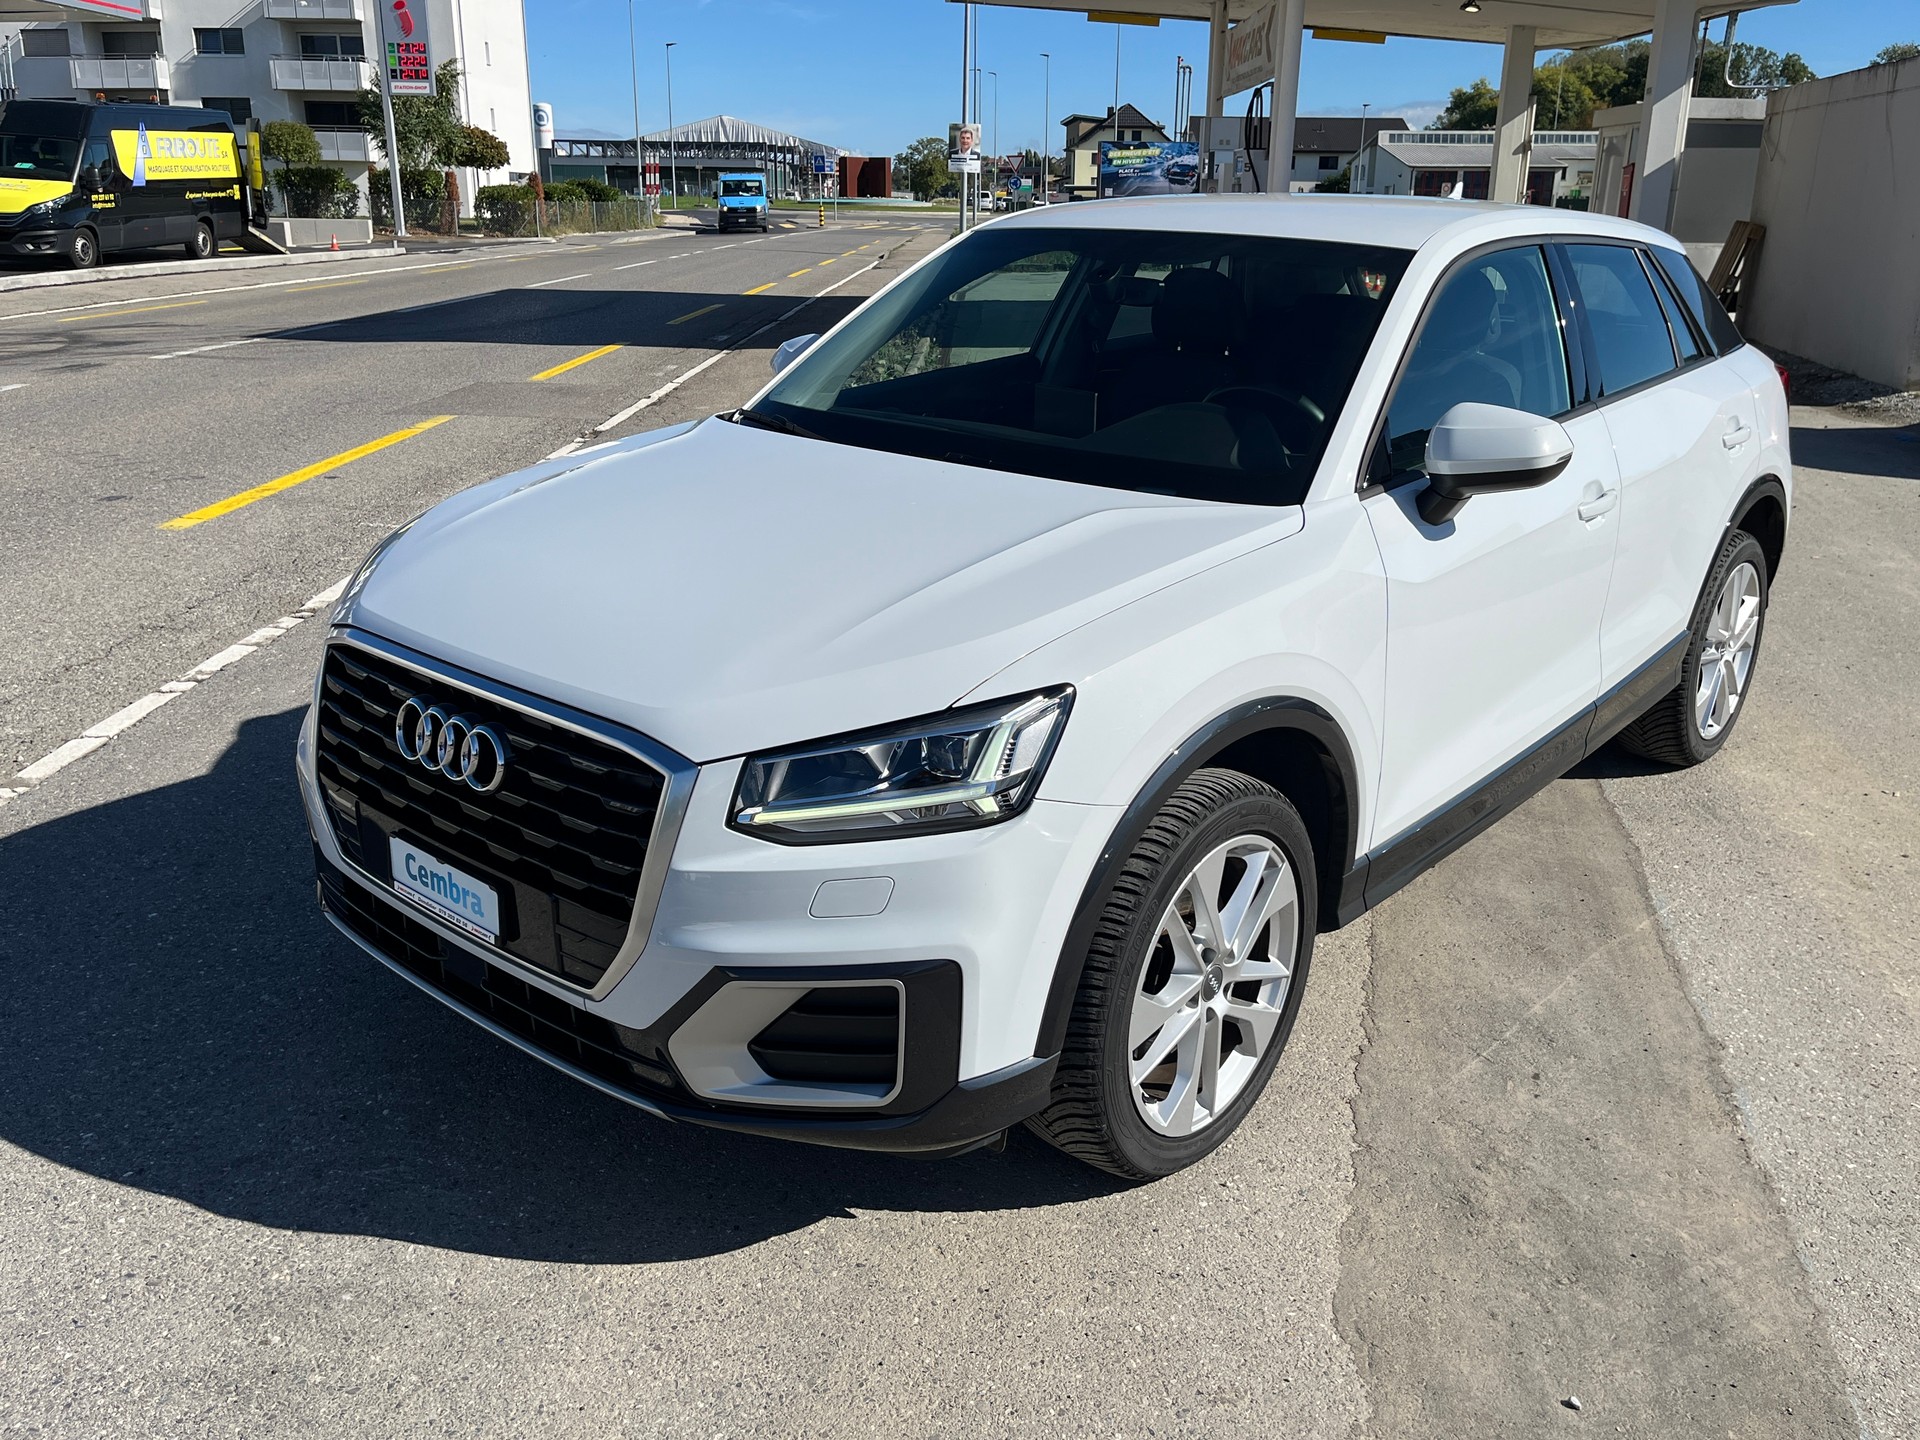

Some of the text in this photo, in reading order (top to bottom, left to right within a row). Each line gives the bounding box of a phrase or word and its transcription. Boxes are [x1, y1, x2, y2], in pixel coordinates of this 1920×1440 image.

[156, 137, 229, 159] FRIROUTE SA
[1109, 150, 1121, 158] DES
[1121, 149, 1142, 157] PNEUS
[148, 165, 173, 173] MARQUAGE
[174, 165, 180, 173] ET
[180, 164, 211, 173] SIGNALISATION
[1215, 164, 1220, 173] 7
[1244, 162, 1251, 172] 5
[405, 853, 484, 918] Cembra
